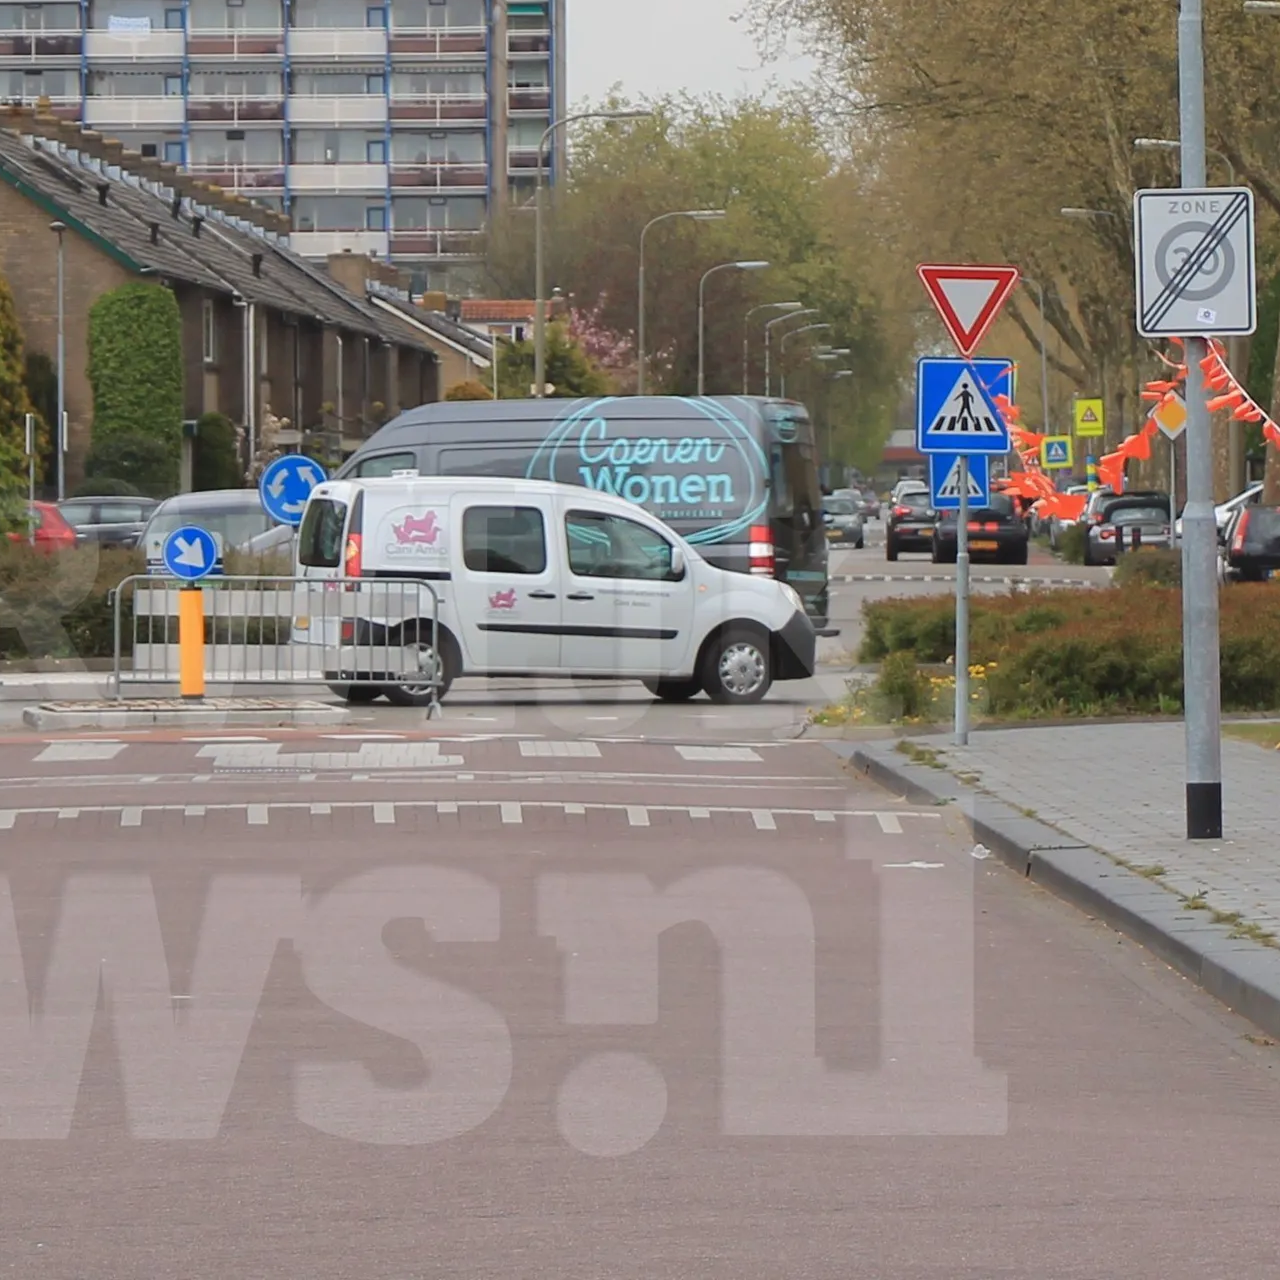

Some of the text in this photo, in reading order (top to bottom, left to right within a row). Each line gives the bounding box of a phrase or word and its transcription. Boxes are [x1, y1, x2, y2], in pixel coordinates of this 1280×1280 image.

[1167, 201, 1221, 214] ZONE
[578, 417, 726, 464] Coenen
[578, 465, 735, 504] Wonen
